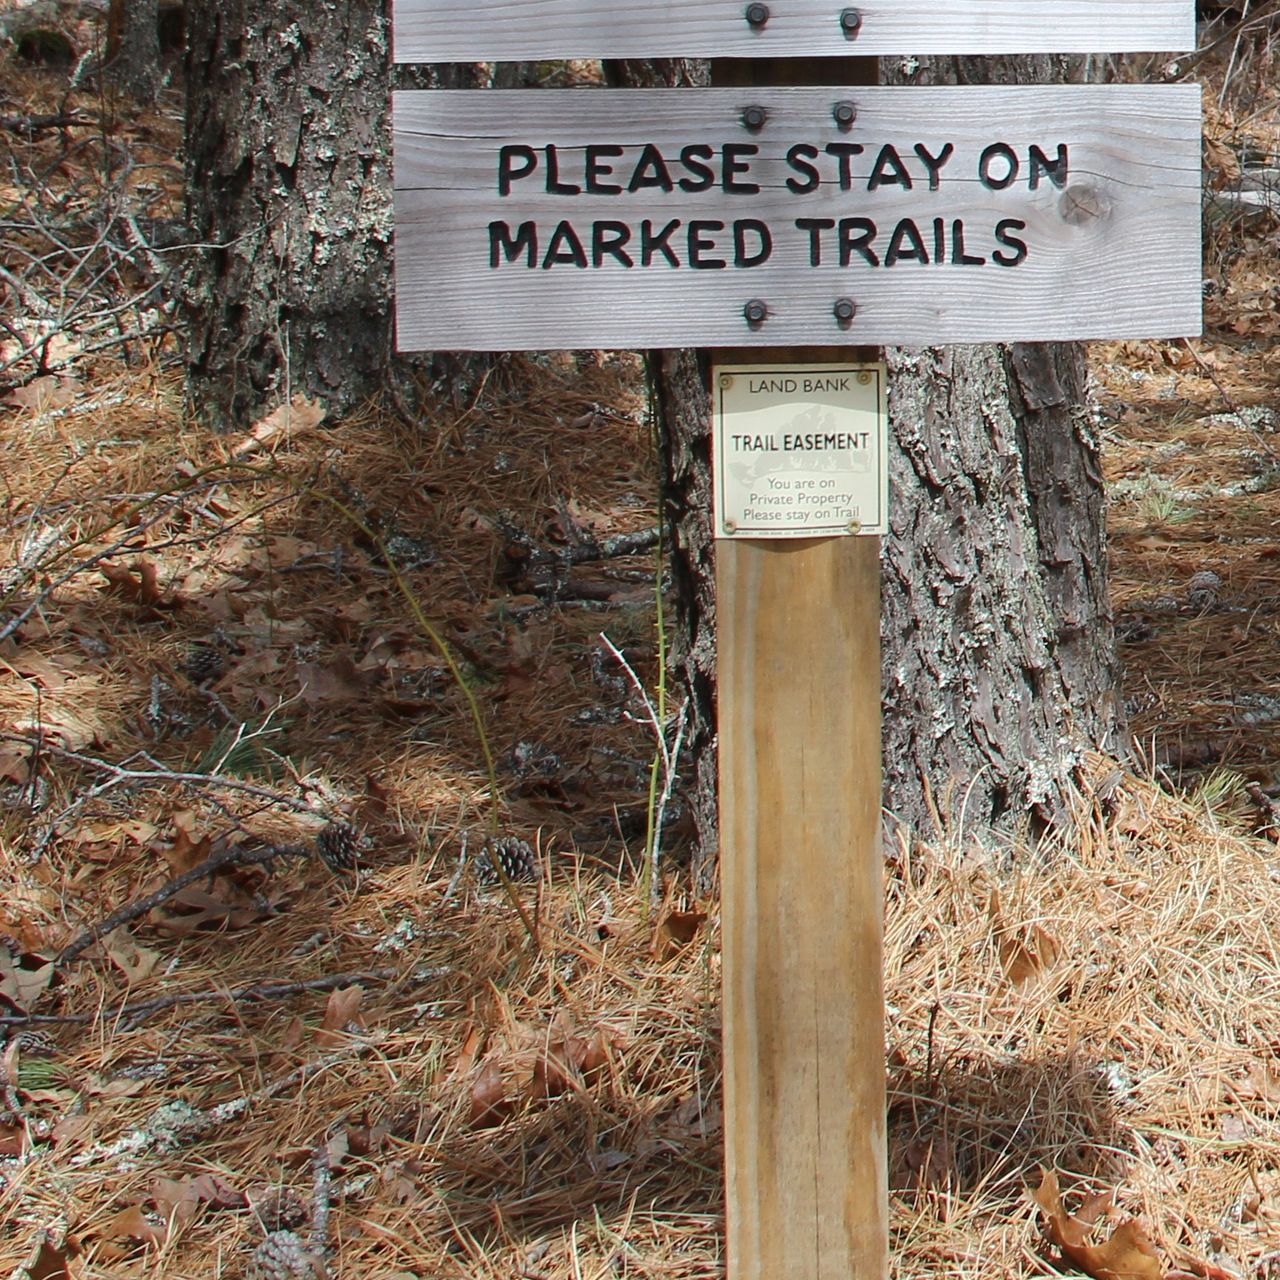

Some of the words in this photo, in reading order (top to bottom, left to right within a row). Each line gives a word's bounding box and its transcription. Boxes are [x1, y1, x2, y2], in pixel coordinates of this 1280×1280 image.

[498, 144, 760, 196] PLEASE
[785, 142, 953, 193] STAY
[979, 143, 1069, 191] ON
[489, 219, 773, 270] MARKED
[796, 217, 1027, 269] TRAILS
[749, 380, 797, 393] LAND
[803, 378, 850, 392] BANK
[732, 434, 779, 451] TRAIL
[784, 432, 869, 450] EASEMENT
[768, 478, 790, 489] You
[795, 480, 815, 489] are
[821, 479, 835, 488] on
[750, 493, 793, 505] Private
[798, 493, 853, 507] Property
[743, 508, 781, 520] Please
[787, 508, 810, 523] stay
[815, 509, 830, 519] on
[834, 506, 860, 518] Trail
